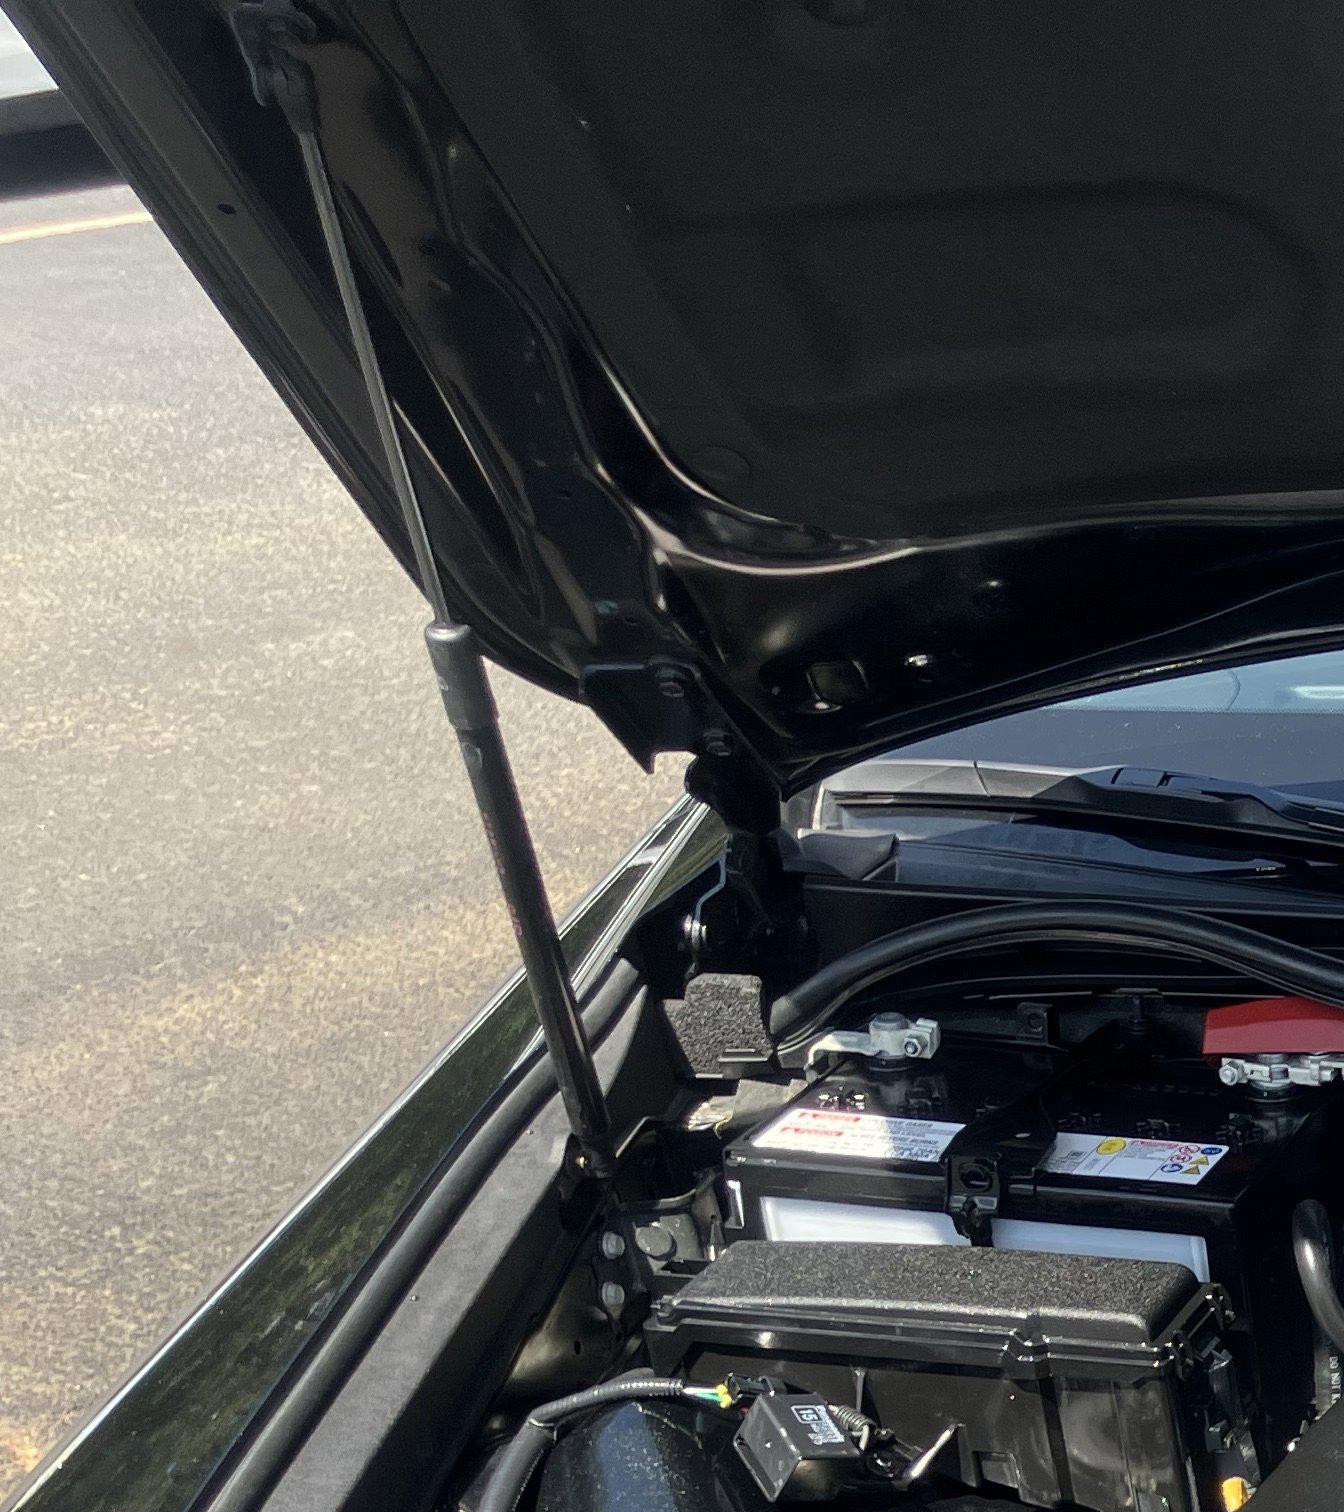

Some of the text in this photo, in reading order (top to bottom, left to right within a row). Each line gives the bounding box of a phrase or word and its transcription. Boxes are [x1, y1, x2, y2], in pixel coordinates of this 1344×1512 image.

[1329, 1356, 1339, 1369] DO
[1330, 1372, 1341, 1390] NOT
[799, 1409, 819, 1421] 15
